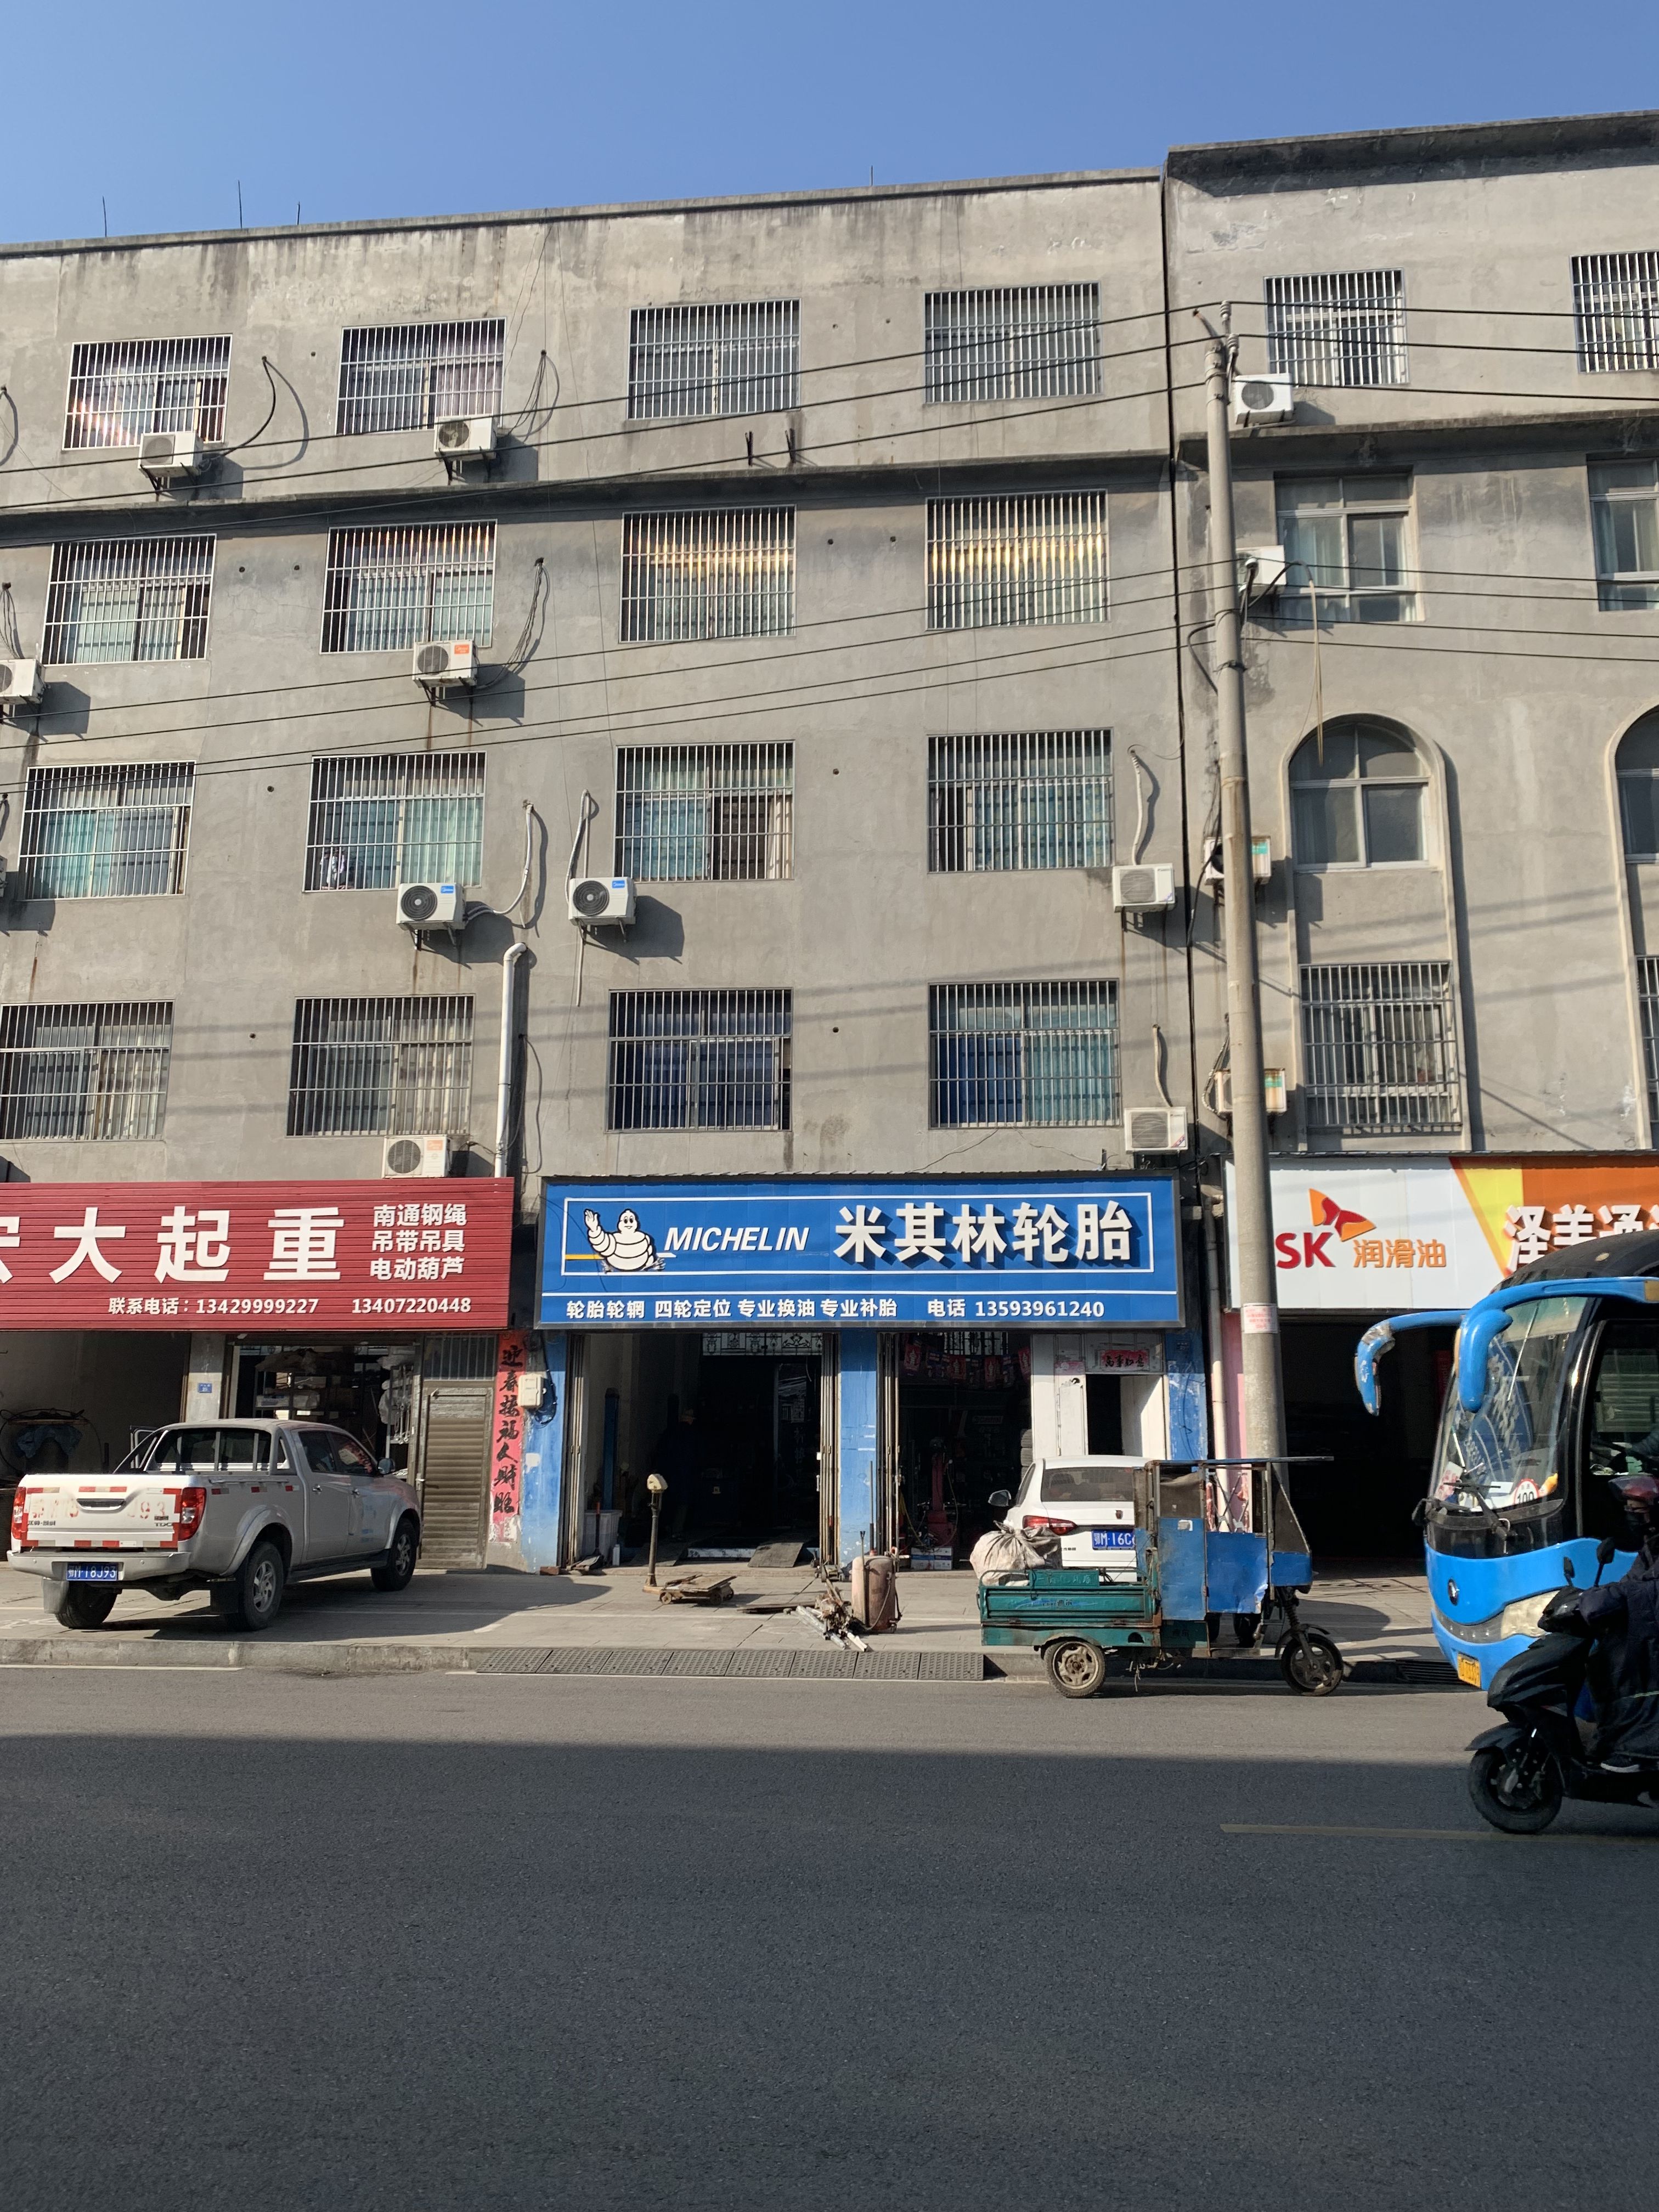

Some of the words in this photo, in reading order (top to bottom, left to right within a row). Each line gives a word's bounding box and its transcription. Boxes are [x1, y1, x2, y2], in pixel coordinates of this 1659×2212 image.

[373, 1203, 467, 1228] 南通钢绳
[371, 1229, 466, 1254] 吊带吊具
[664, 1227, 809, 1252] MICHELIN
[834, 1200, 1133, 1263] 米其林轮胎
[1275, 1233, 1334, 1269] SK
[1353, 1239, 1447, 1269] 润滑油
[370, 1257, 465, 1282] 电动葫芦
[352, 1297, 471, 1314] 13407220448
[566, 1300, 645, 1319] 轮胎轮辋
[654, 1299, 732, 1318] 四轮定位
[737, 1299, 815, 1318] 专业换油
[820, 1298, 898, 1317] 专业补胎
[927, 1298, 966, 1317] 电话
[975, 1300, 1105, 1317] 13593961240
